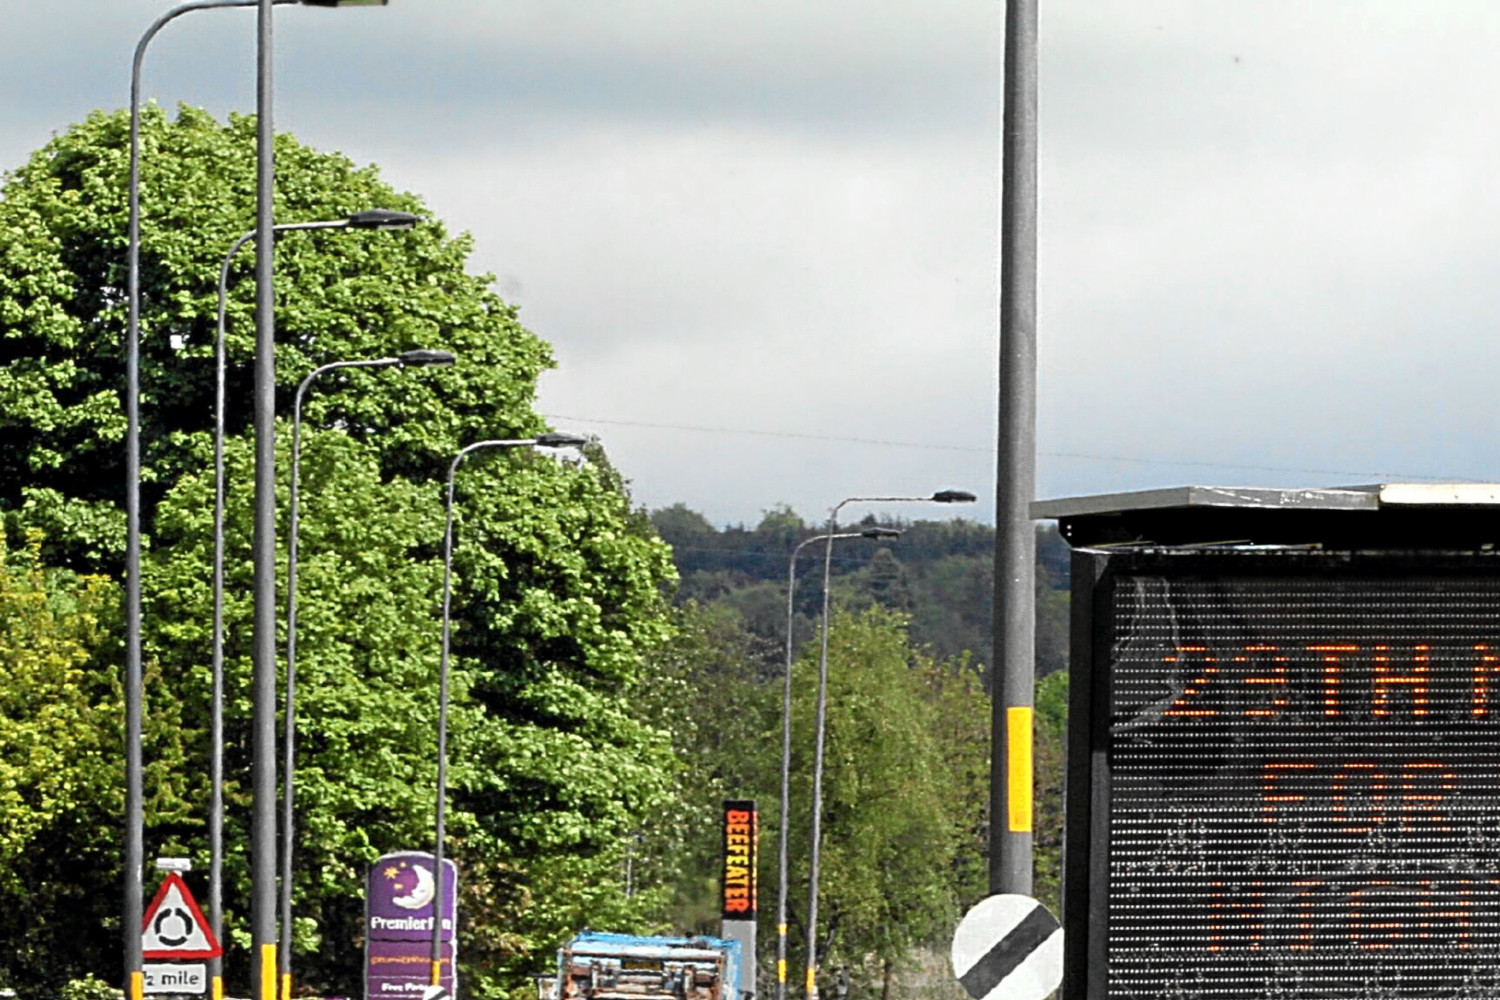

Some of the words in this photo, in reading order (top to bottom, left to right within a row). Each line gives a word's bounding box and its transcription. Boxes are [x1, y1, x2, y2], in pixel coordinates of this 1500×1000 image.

[1262, 762, 1458, 833] FOR
[726, 809, 751, 912] BEEFEATER
[371, 916, 428, 930] Premier
[428, 916, 452, 930] In
[161, 970, 199, 985] mile
